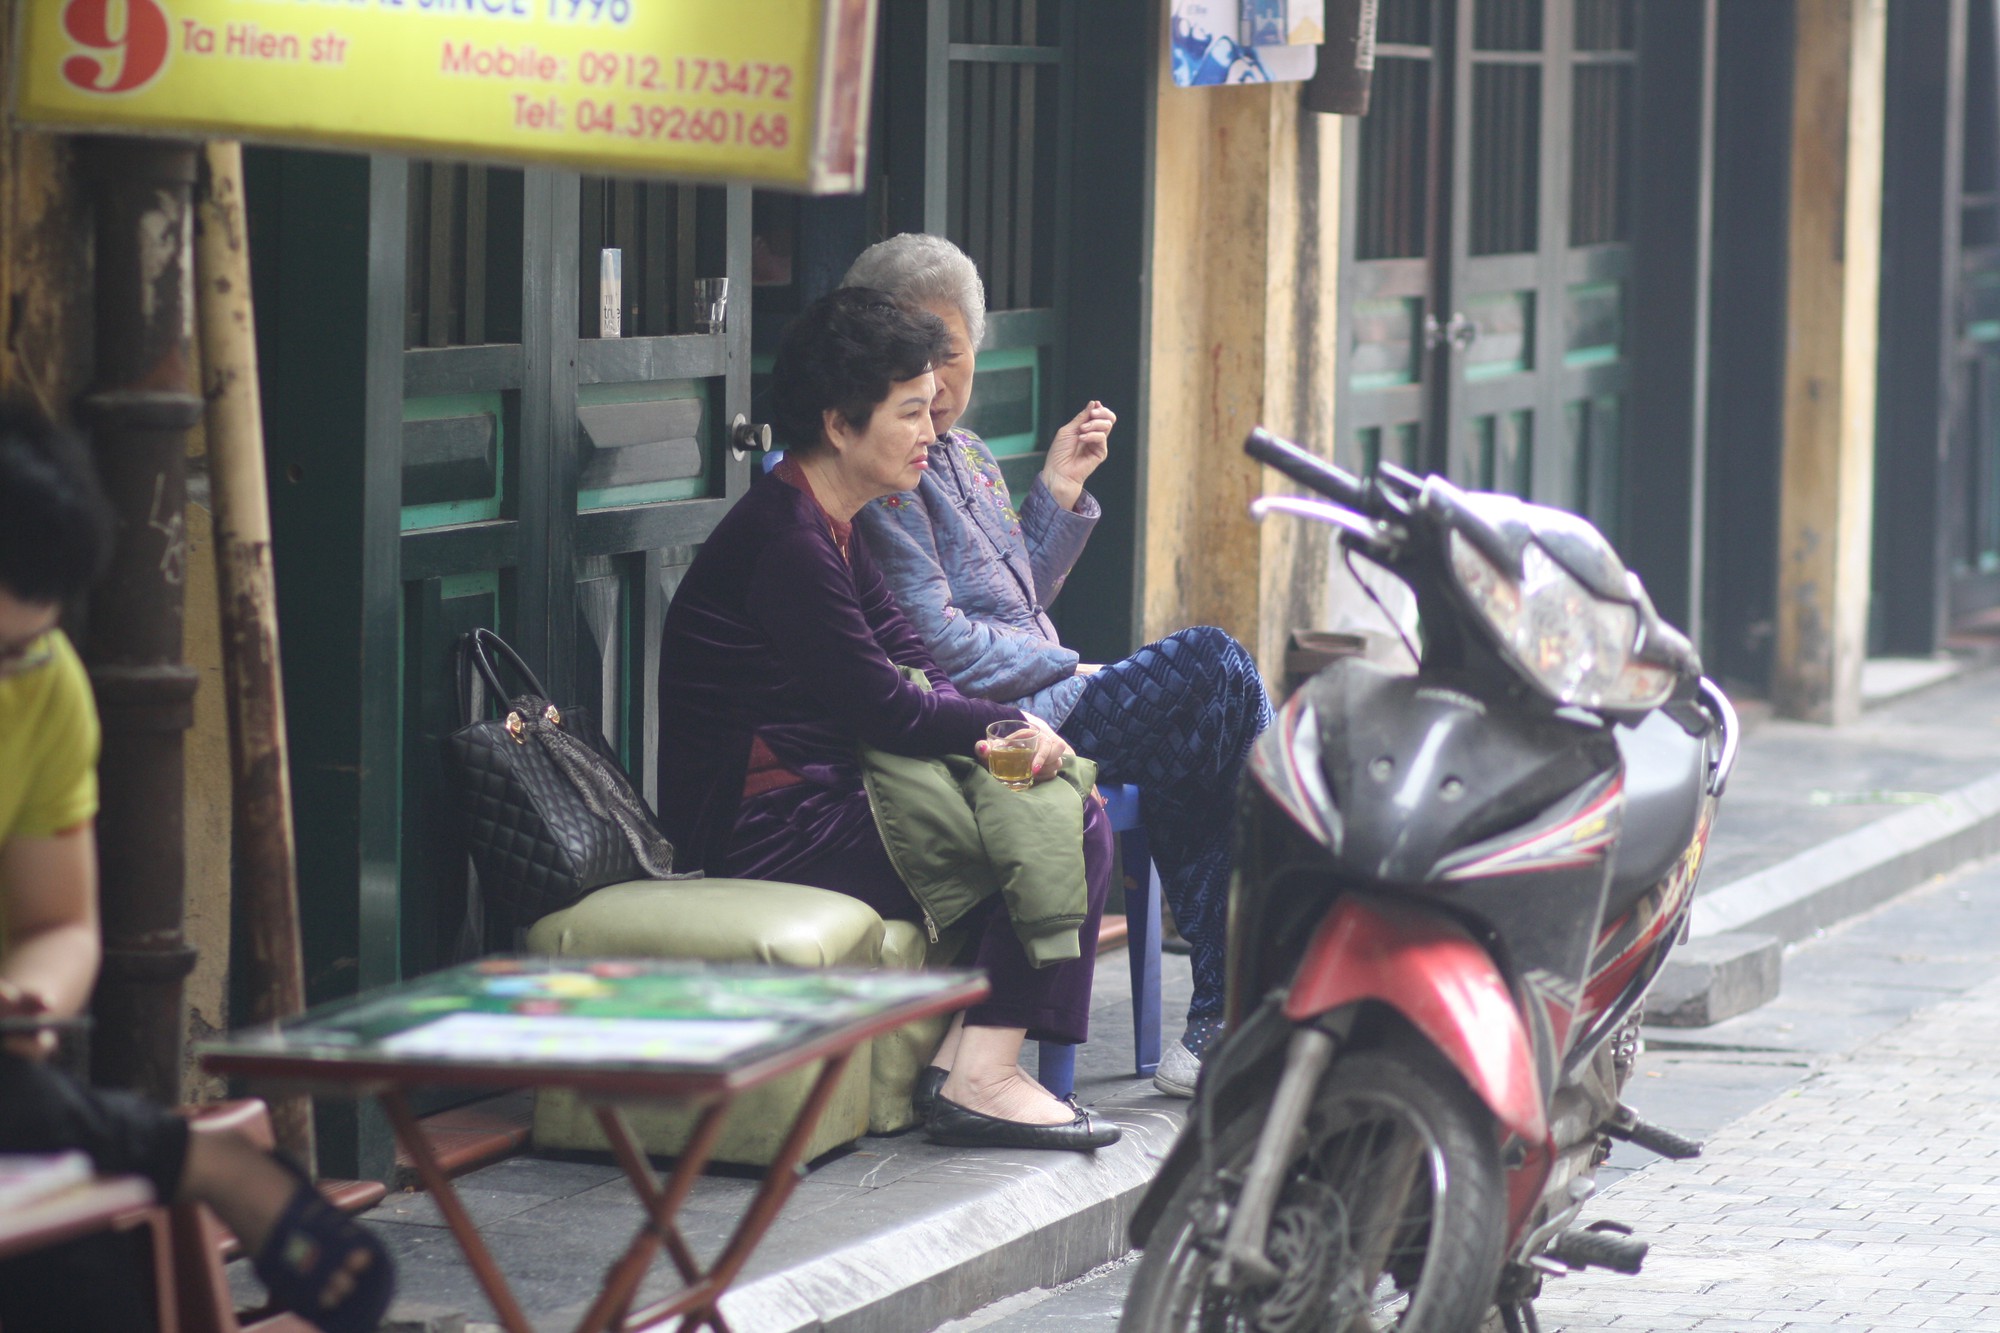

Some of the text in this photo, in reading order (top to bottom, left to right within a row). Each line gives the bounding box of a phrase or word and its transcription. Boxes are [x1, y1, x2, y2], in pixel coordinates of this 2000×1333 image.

[63, 0, 346, 93] 9 Ta Hien str
[442, 42, 793, 99] Mobile: 0912.173472
[513, 93, 789, 148] Tel: 04.39260168
